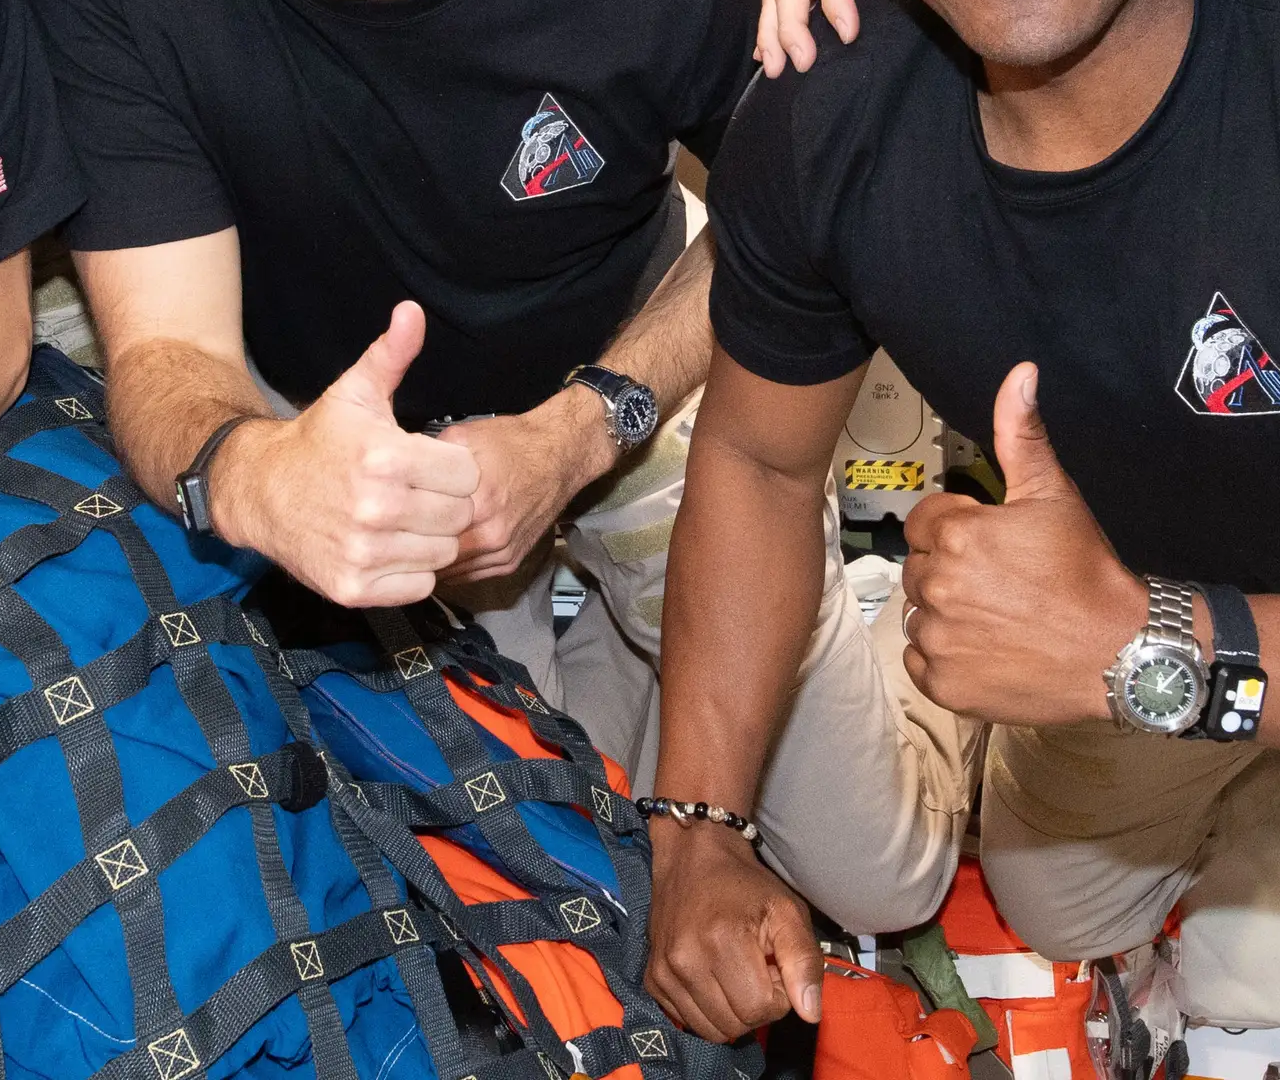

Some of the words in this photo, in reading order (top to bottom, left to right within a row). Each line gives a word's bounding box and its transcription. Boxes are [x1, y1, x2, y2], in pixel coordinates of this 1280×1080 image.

[874, 383, 895, 392] GN2
[871, 392, 892, 400] Tank
[894, 392, 900, 400] 2
